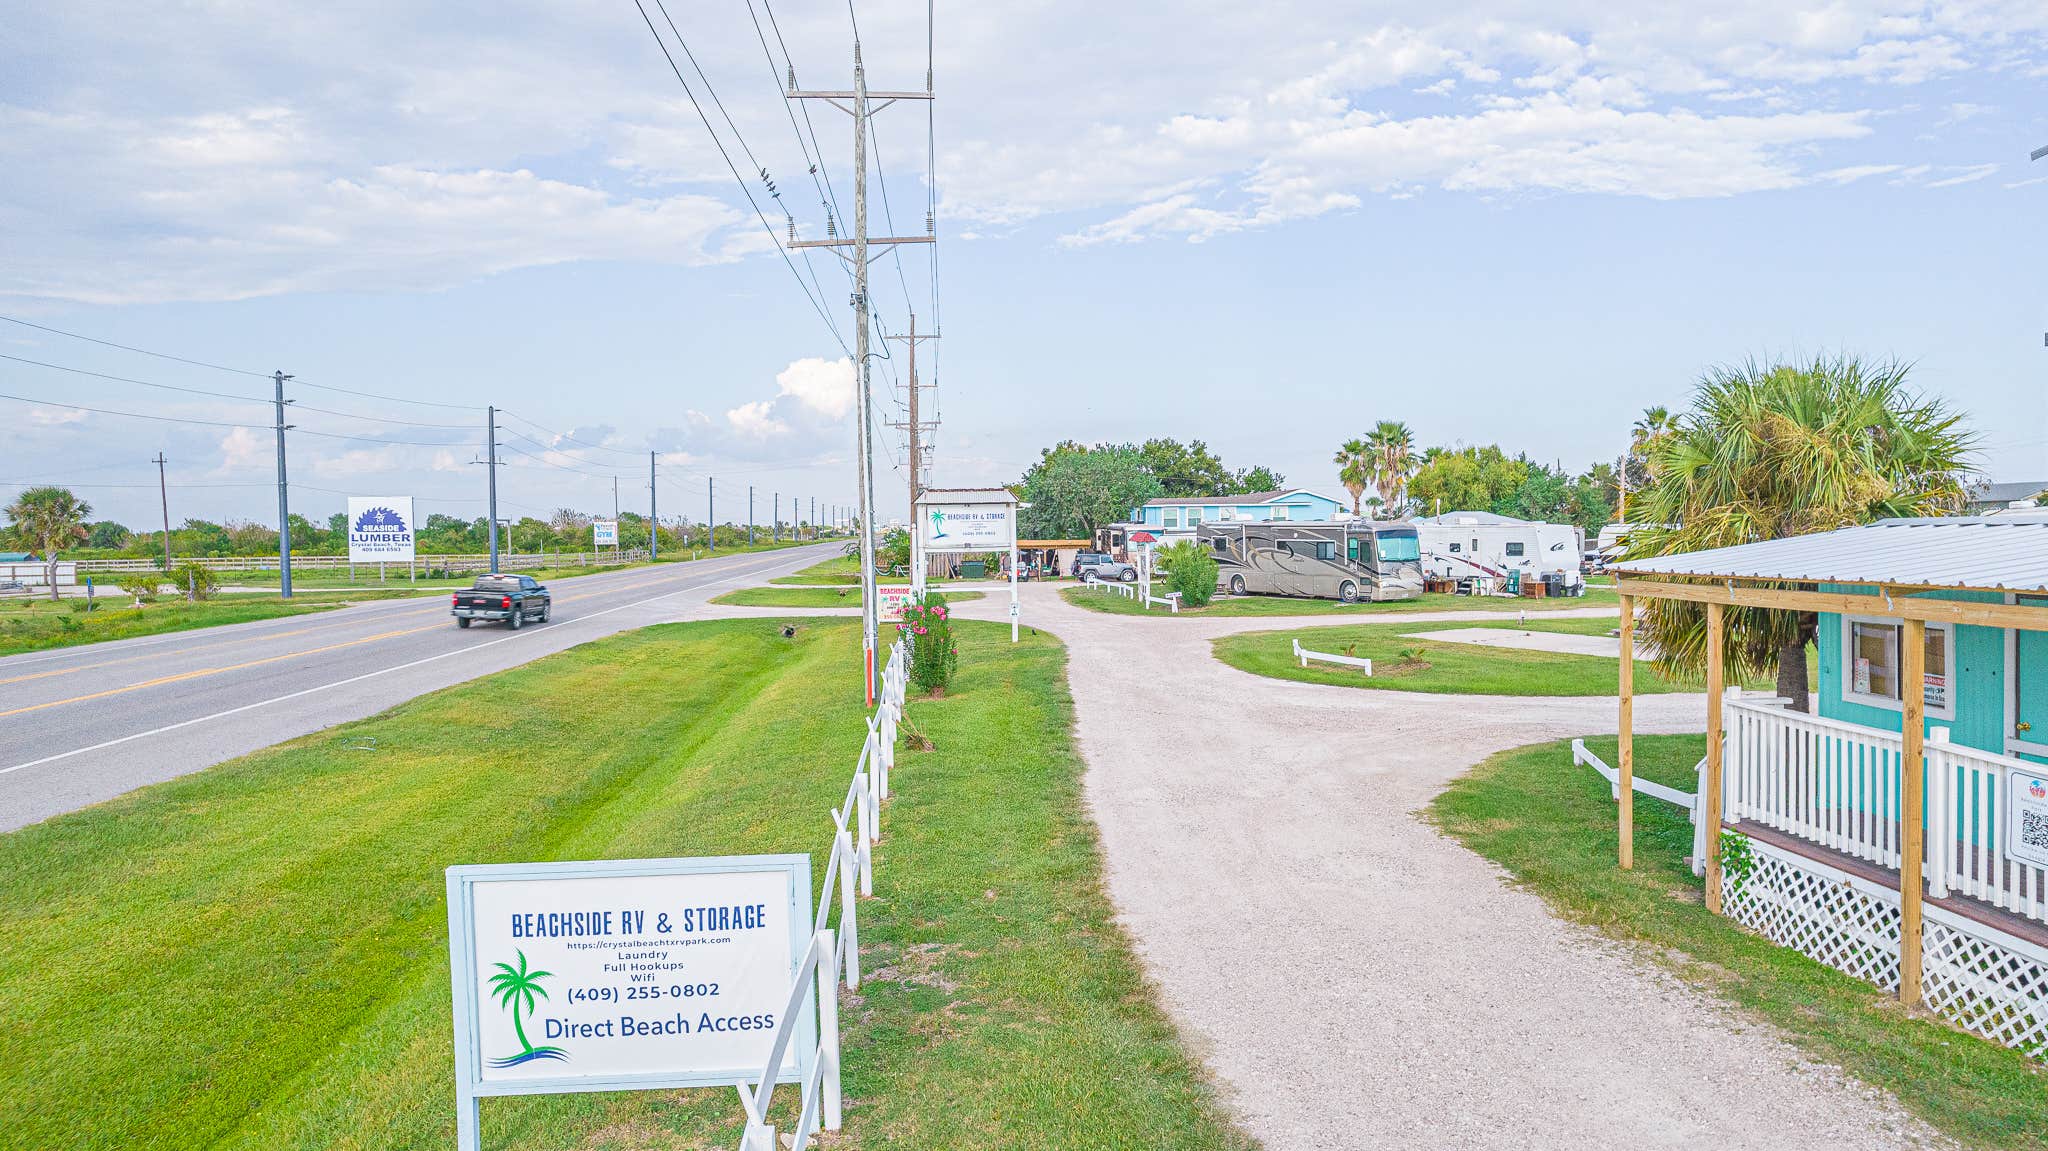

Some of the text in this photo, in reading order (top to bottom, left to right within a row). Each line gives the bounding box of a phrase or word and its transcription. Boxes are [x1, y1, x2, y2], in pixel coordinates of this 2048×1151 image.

[351, 534, 411, 542] LUMBER
[512, 904, 766, 937] BEACHSIDE RV & STORAGE
[567, 936, 731, 950] https://crystalbeachtxrvpark.com
[618, 950, 668, 961] Laundry
[604, 961, 684, 974] Full Hookups
[630, 973, 656, 982] Wifi
[568, 983, 720, 1004] (409) 255-0802
[545, 1012, 775, 1039] Direct Beach Access
